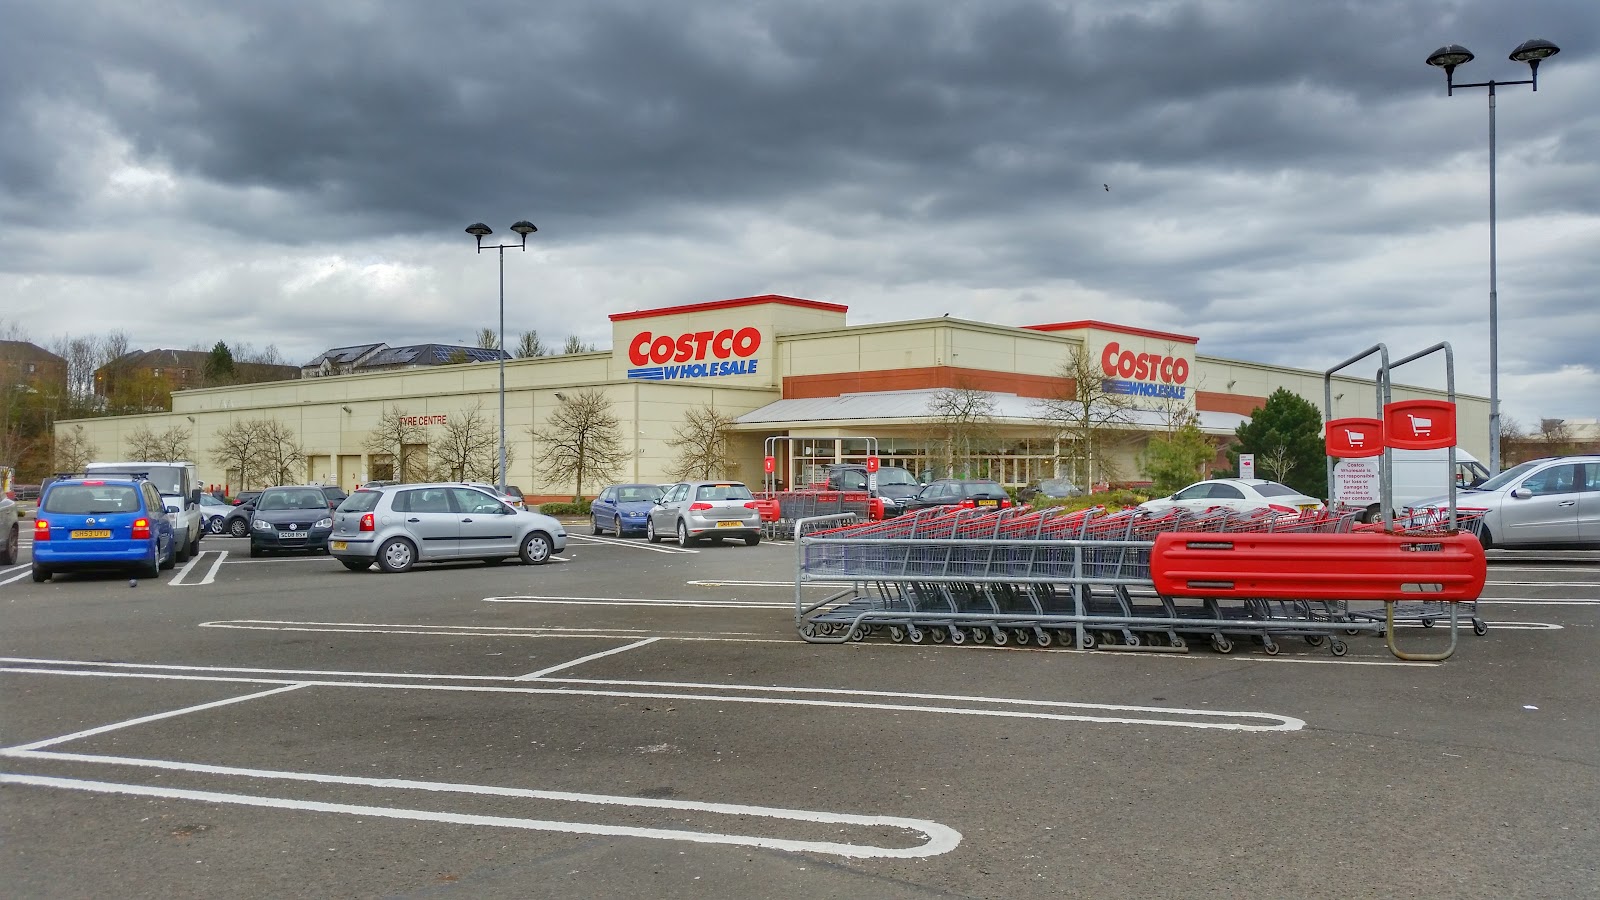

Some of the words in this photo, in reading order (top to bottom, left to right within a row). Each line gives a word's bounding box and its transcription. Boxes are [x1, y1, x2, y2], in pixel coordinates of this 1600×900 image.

[629, 327, 761, 366] COSTCO
[663, 359, 758, 380] WHOLESALE
[1101, 342, 1189, 385] COSTCO
[1129, 382, 1186, 399] WHOLESALE
[399, 416, 417, 426] TYRE
[418, 415, 446, 426] CENTRE
